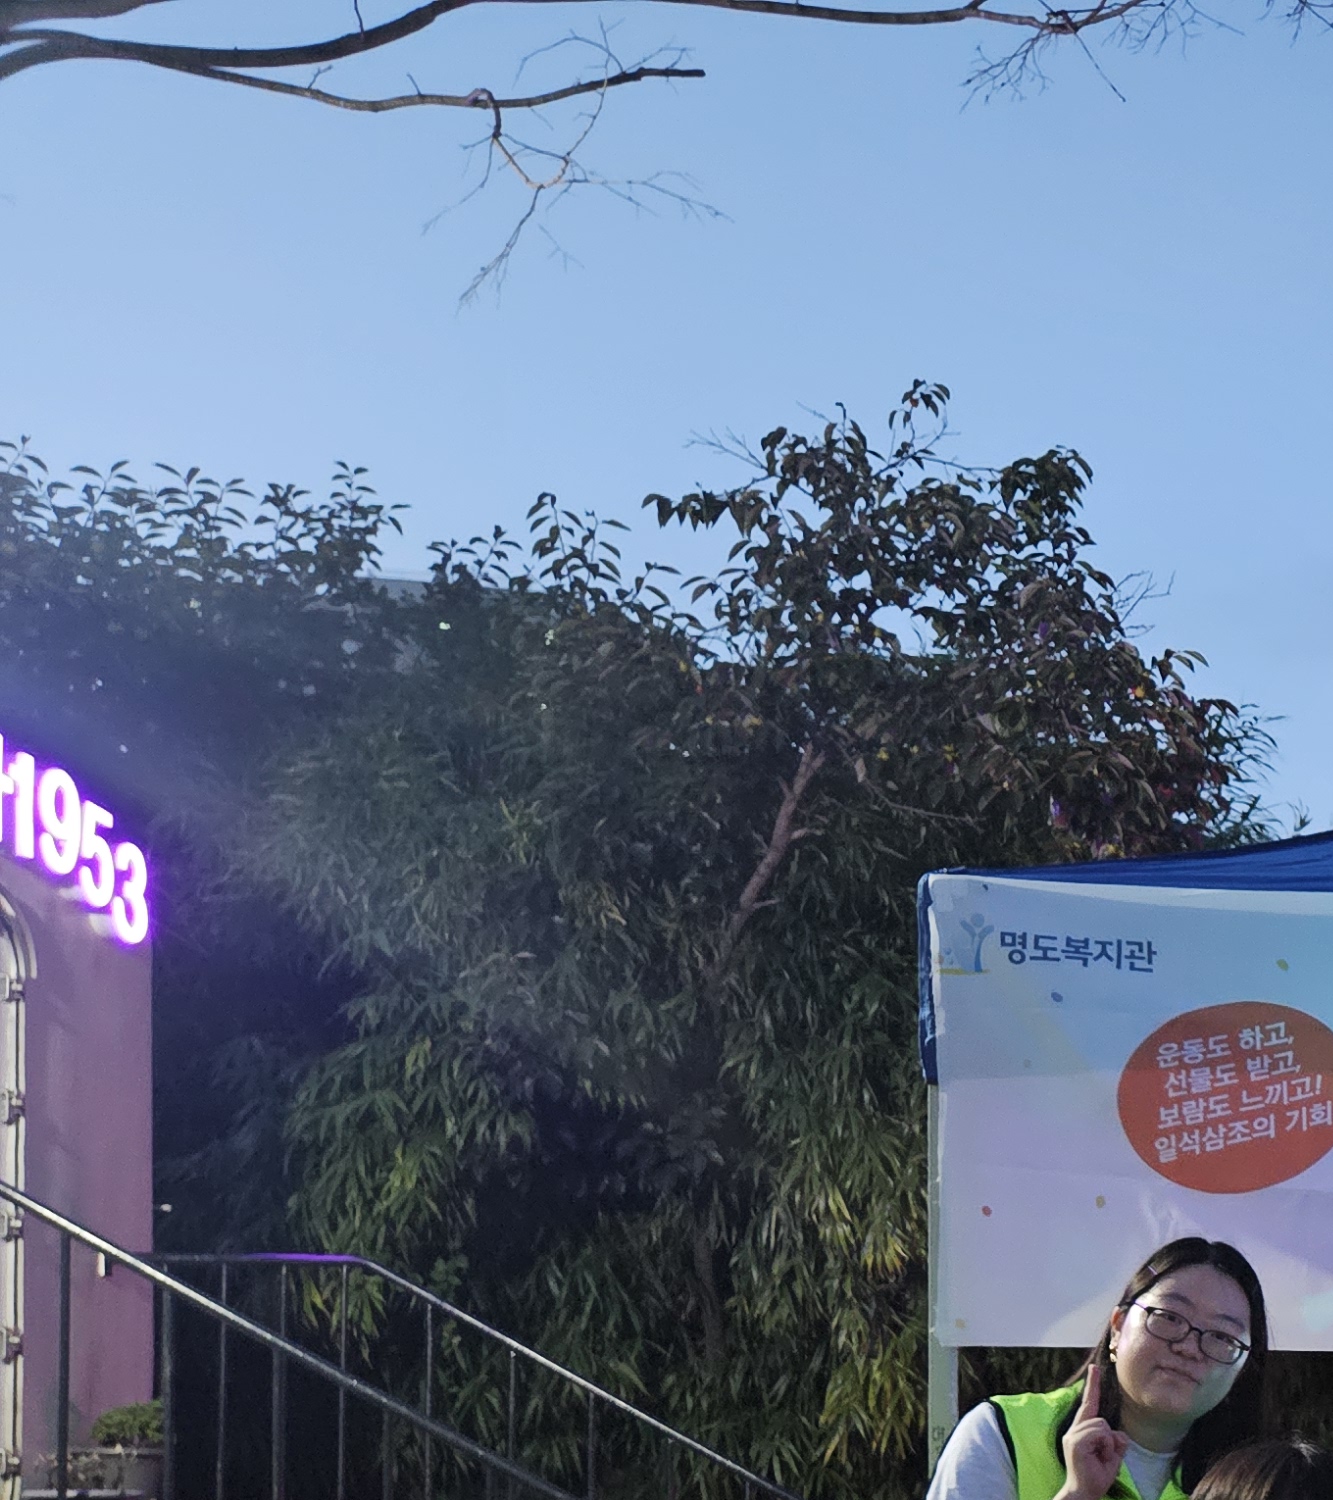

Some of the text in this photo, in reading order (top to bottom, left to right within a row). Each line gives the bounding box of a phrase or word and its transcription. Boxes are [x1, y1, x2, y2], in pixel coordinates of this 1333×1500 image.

[0, 735, 149, 945] 1953
[1000, 931, 1157, 973] 명도복지관
[1156, 1021, 1295, 1069] 운동도 하고,
[1164, 1050, 1301, 1098] 선물도 받고,
[1157, 1074, 1323, 1130] 보람도 느끼고!
[1154, 1113, 1276, 1164] 일석삼조의
